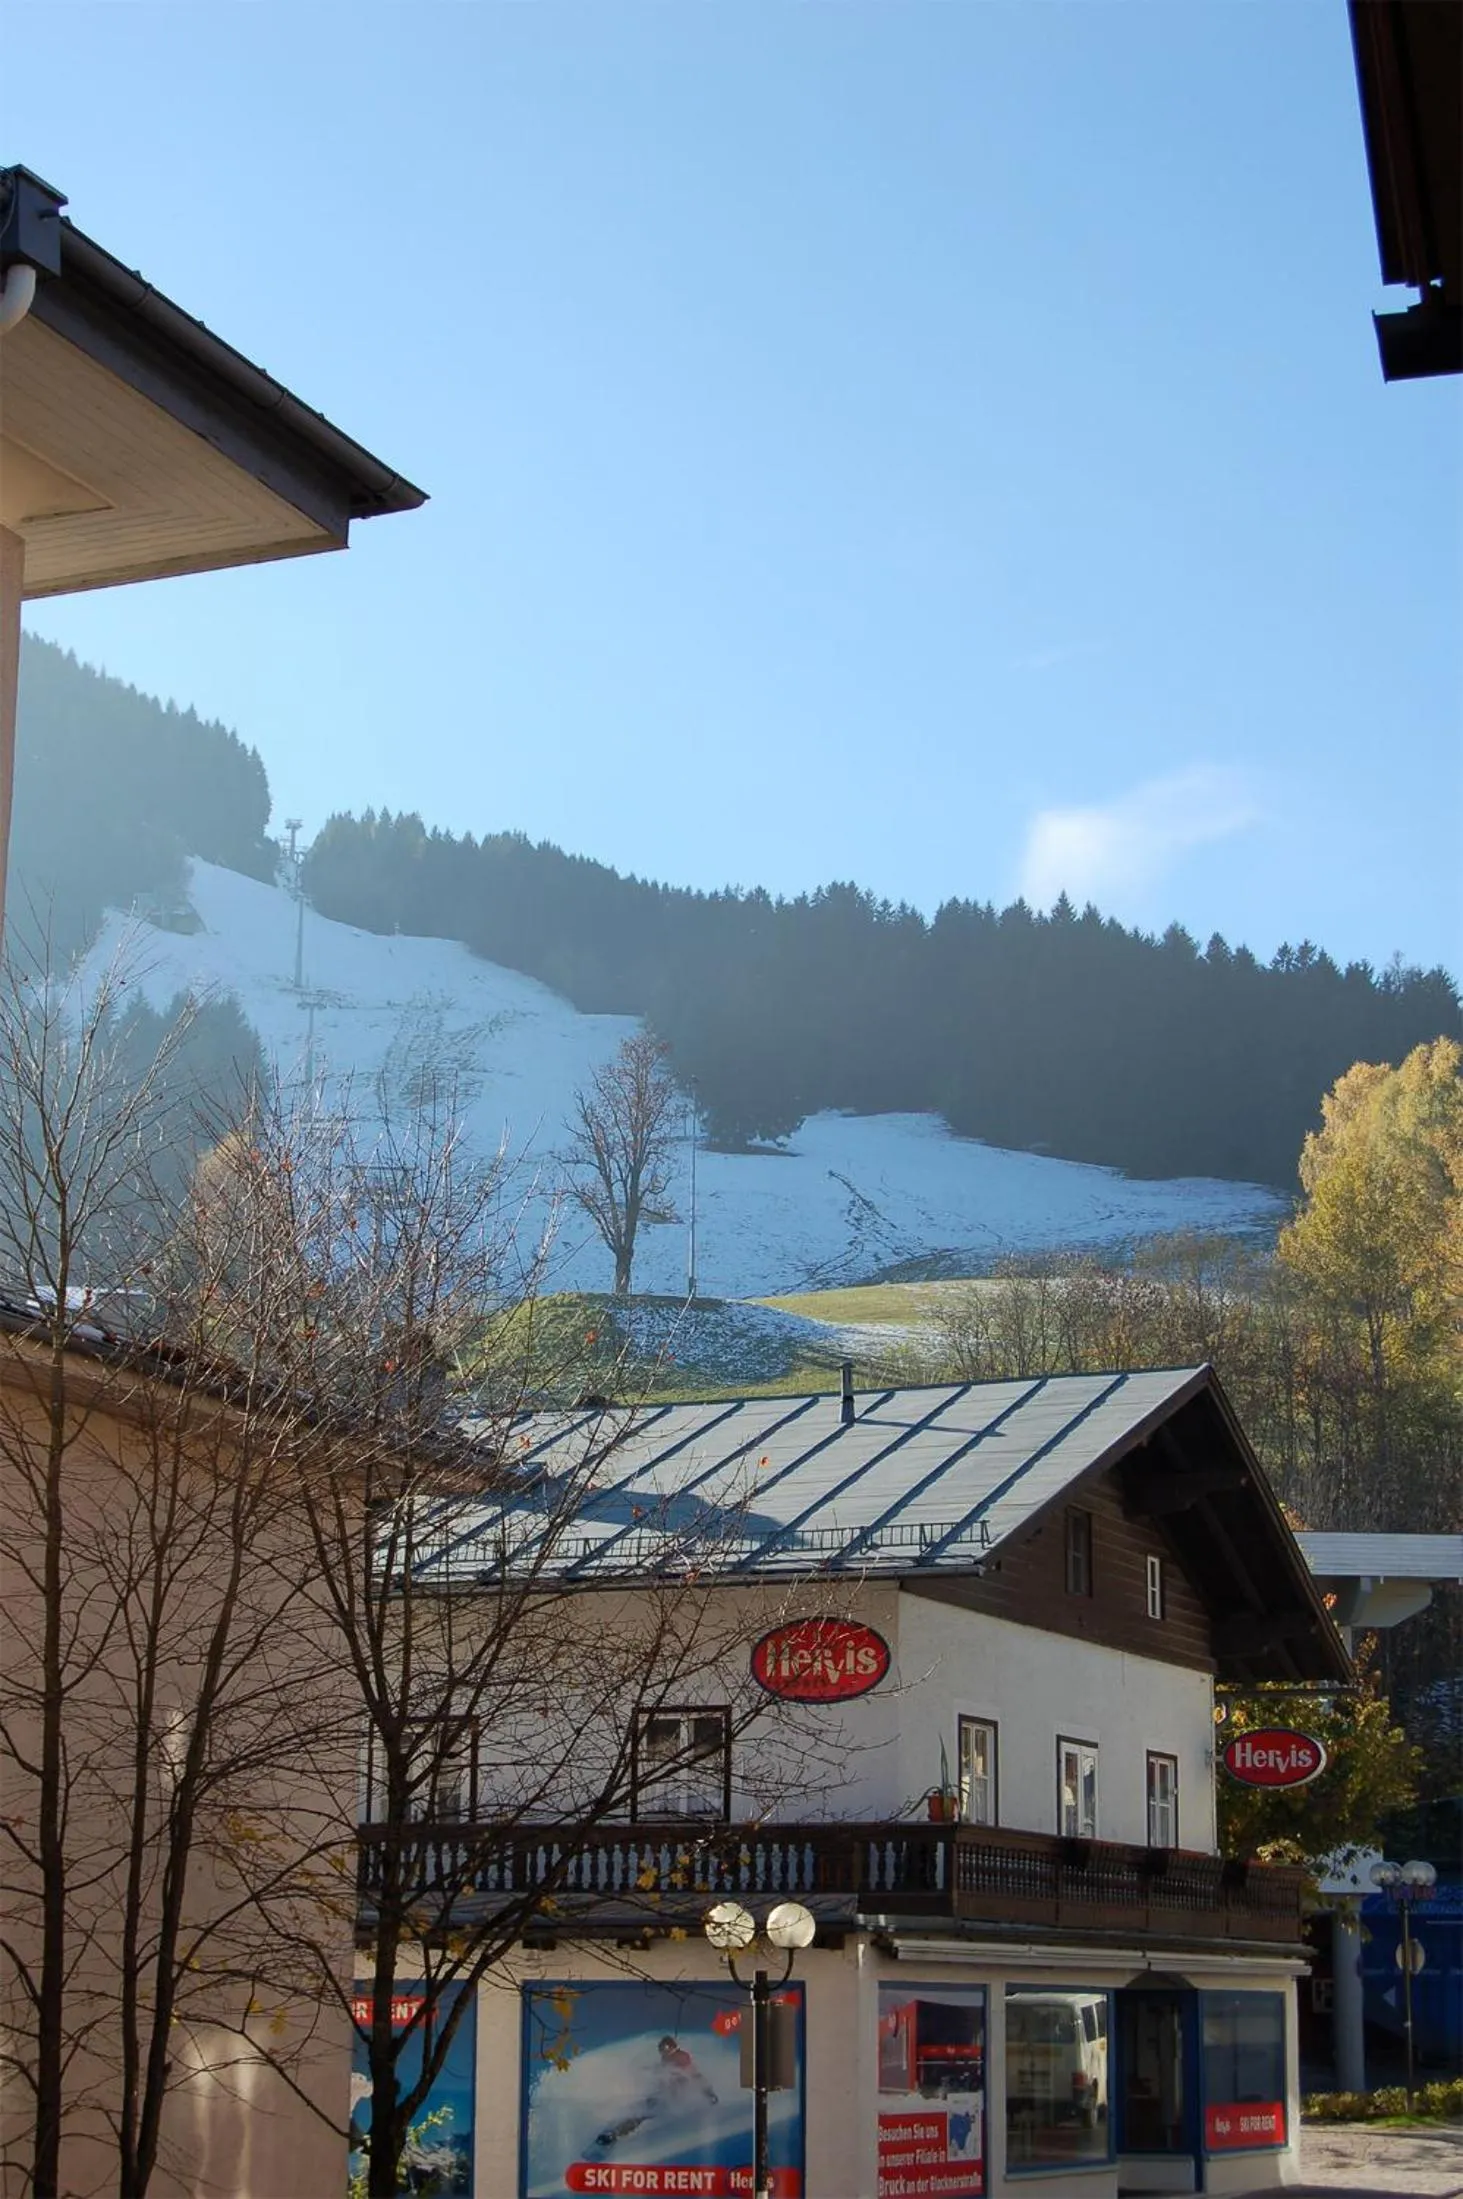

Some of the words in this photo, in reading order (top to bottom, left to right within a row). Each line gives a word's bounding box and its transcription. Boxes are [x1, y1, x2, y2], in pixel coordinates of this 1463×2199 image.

[766, 1640, 878, 1684] Hervis
[1235, 1742, 1312, 1773] Hervis
[913, 2123, 925, 2140] Sie
[926, 2125, 939, 2139] uns
[584, 2168, 615, 2188] SKI
[622, 2169, 659, 2189] FOR
[664, 2171, 716, 2190] RENT
[730, 2172, 775, 2190] Hers
[879, 2174, 905, 2196] Bruck
[916, 2177, 929, 2193] der
